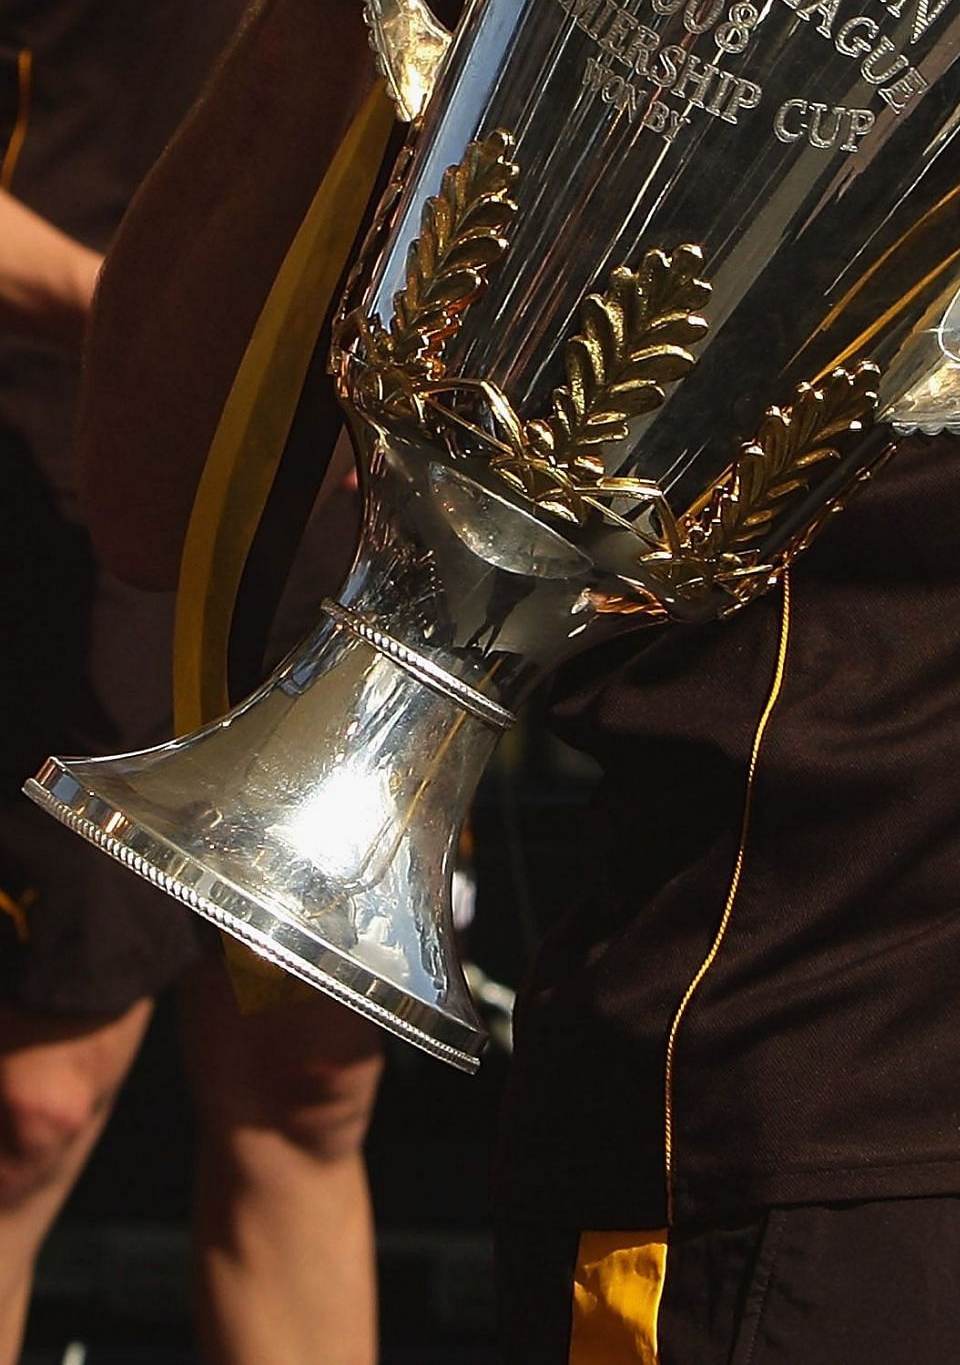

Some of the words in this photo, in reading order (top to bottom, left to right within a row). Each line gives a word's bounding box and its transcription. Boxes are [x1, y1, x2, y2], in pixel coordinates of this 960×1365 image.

[582, 58, 646, 123] WON
[645, 101, 691, 141] BY
[774, 97, 875, 152] CUP
